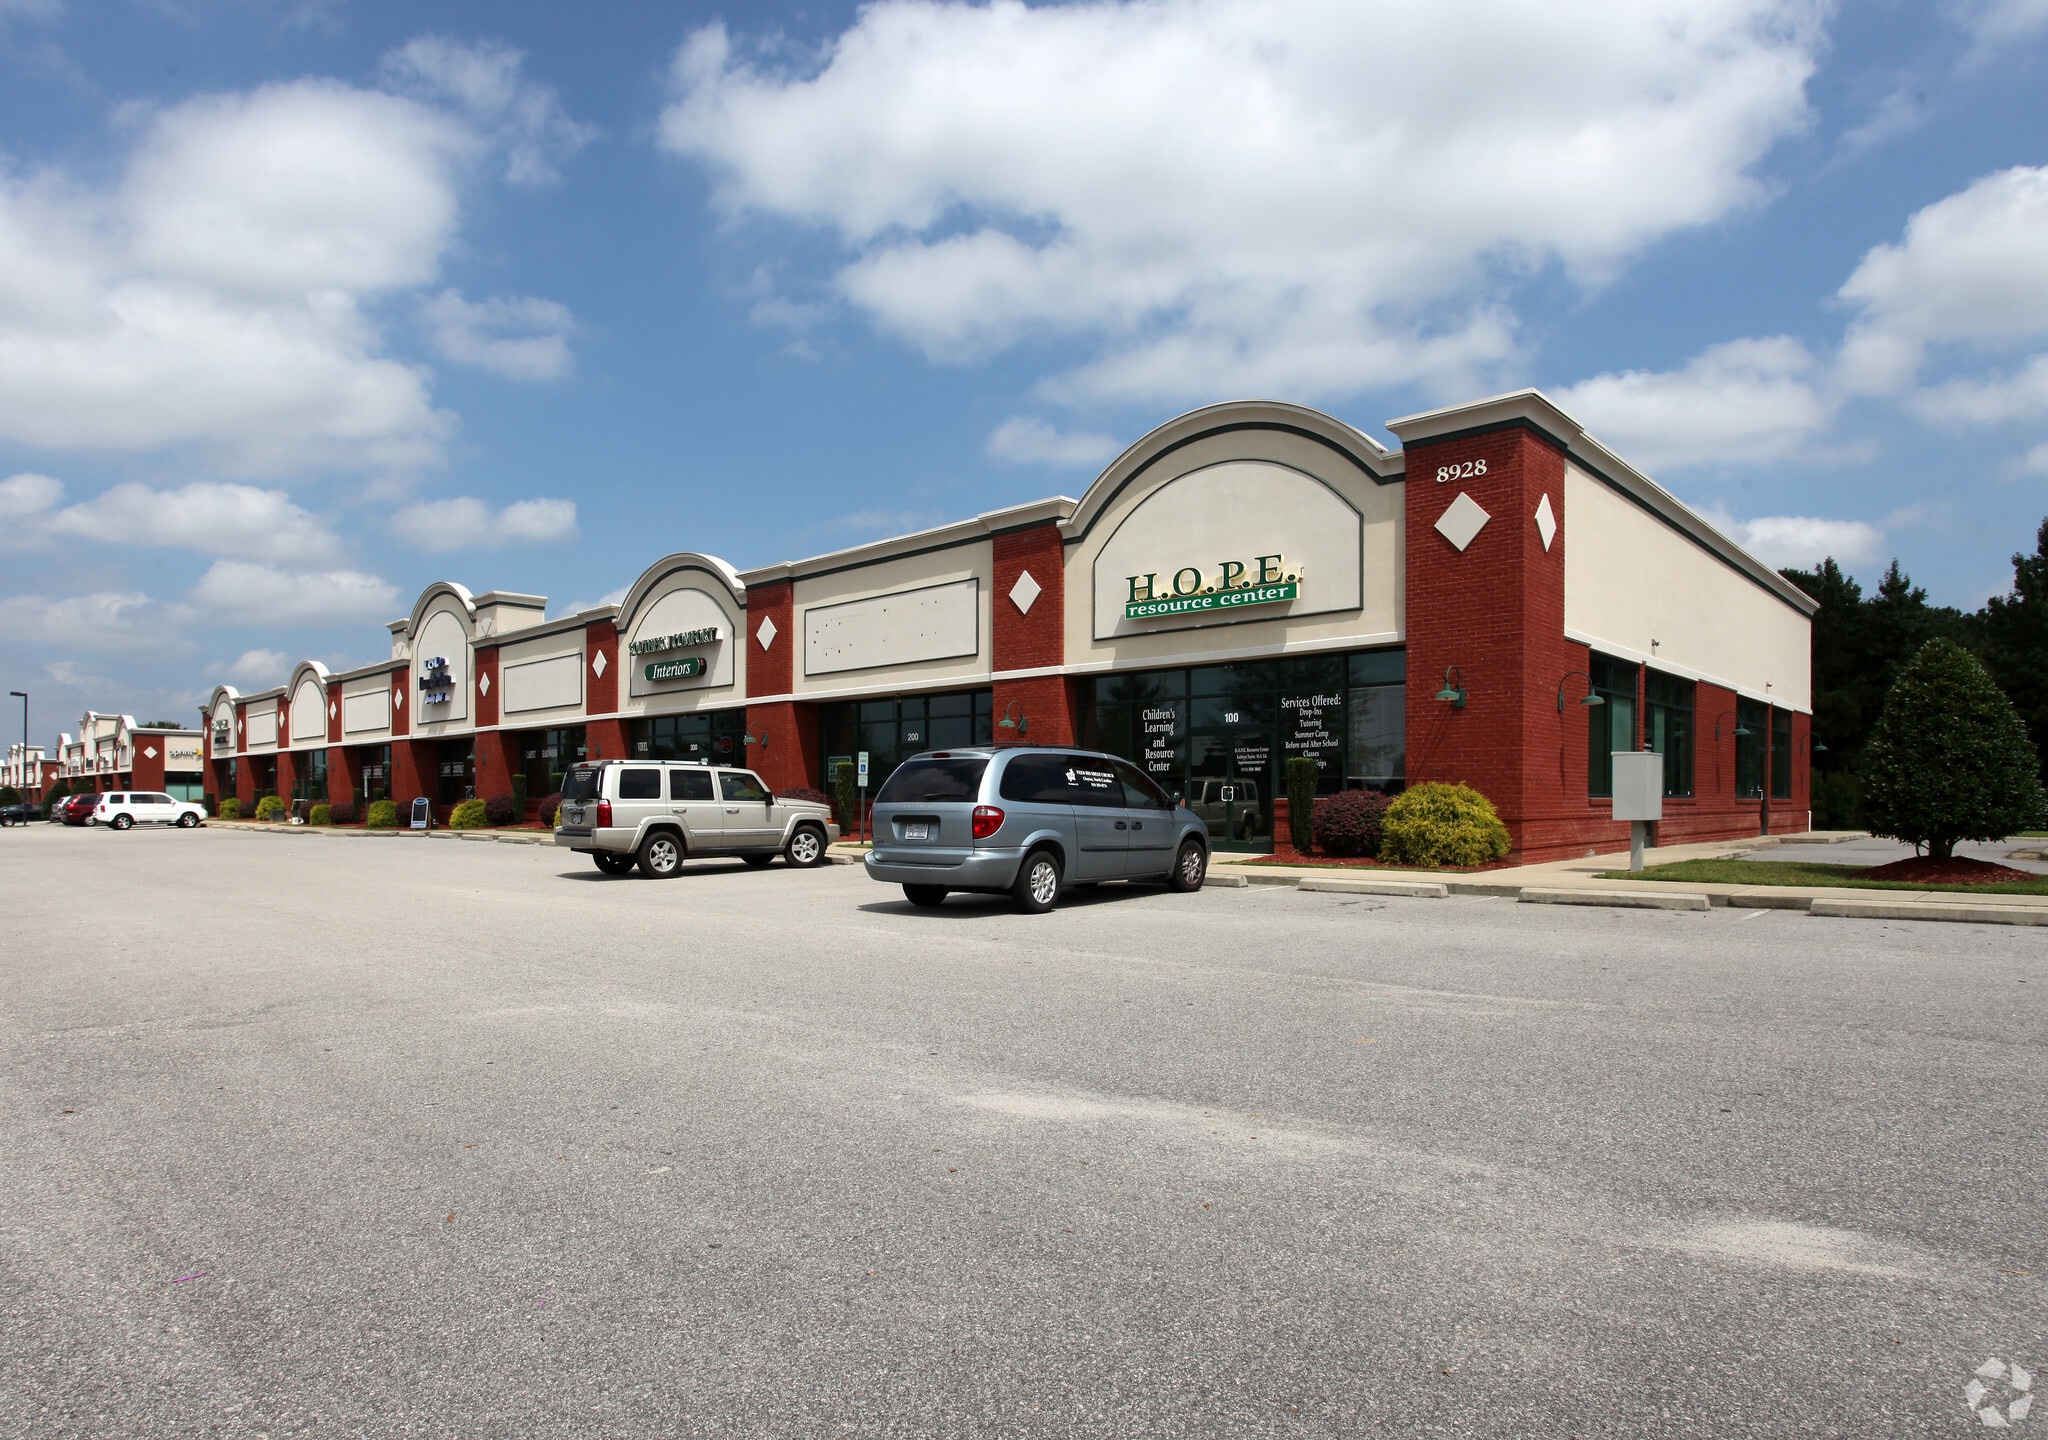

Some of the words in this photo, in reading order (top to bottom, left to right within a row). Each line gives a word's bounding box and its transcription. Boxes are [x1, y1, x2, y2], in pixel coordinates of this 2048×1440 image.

[1436, 459, 1488, 484] 8928
[1125, 554, 1298, 604] H.O.P.E.
[1128, 597, 1213, 617] resource
[1219, 586, 1289, 606] center
[652, 662, 691, 679] Interiors
[1281, 696, 1310, 709] Services
[1311, 694, 1341, 707] Offered:
[1142, 708, 1176, 720] Children's
[1224, 712, 1239, 723] 100
[1299, 707, 1322, 718] Drop-Ins
[1144, 721, 1175, 736] Learning
[1299, 719, 1322, 729] Tutoring
[907, 733, 919, 741] 200
[1294, 731, 1314, 739] Summer
[1314, 729, 1329, 740] Camp
[1152, 736, 1165, 748] and
[1285, 741, 1300, 749] Before
[1300, 740, 1309, 748] and
[1309, 740, 1322, 748] After
[1322, 739, 1339, 747] School
[1144, 748, 1175, 759] Resource
[1148, 760, 1171, 771] Center
